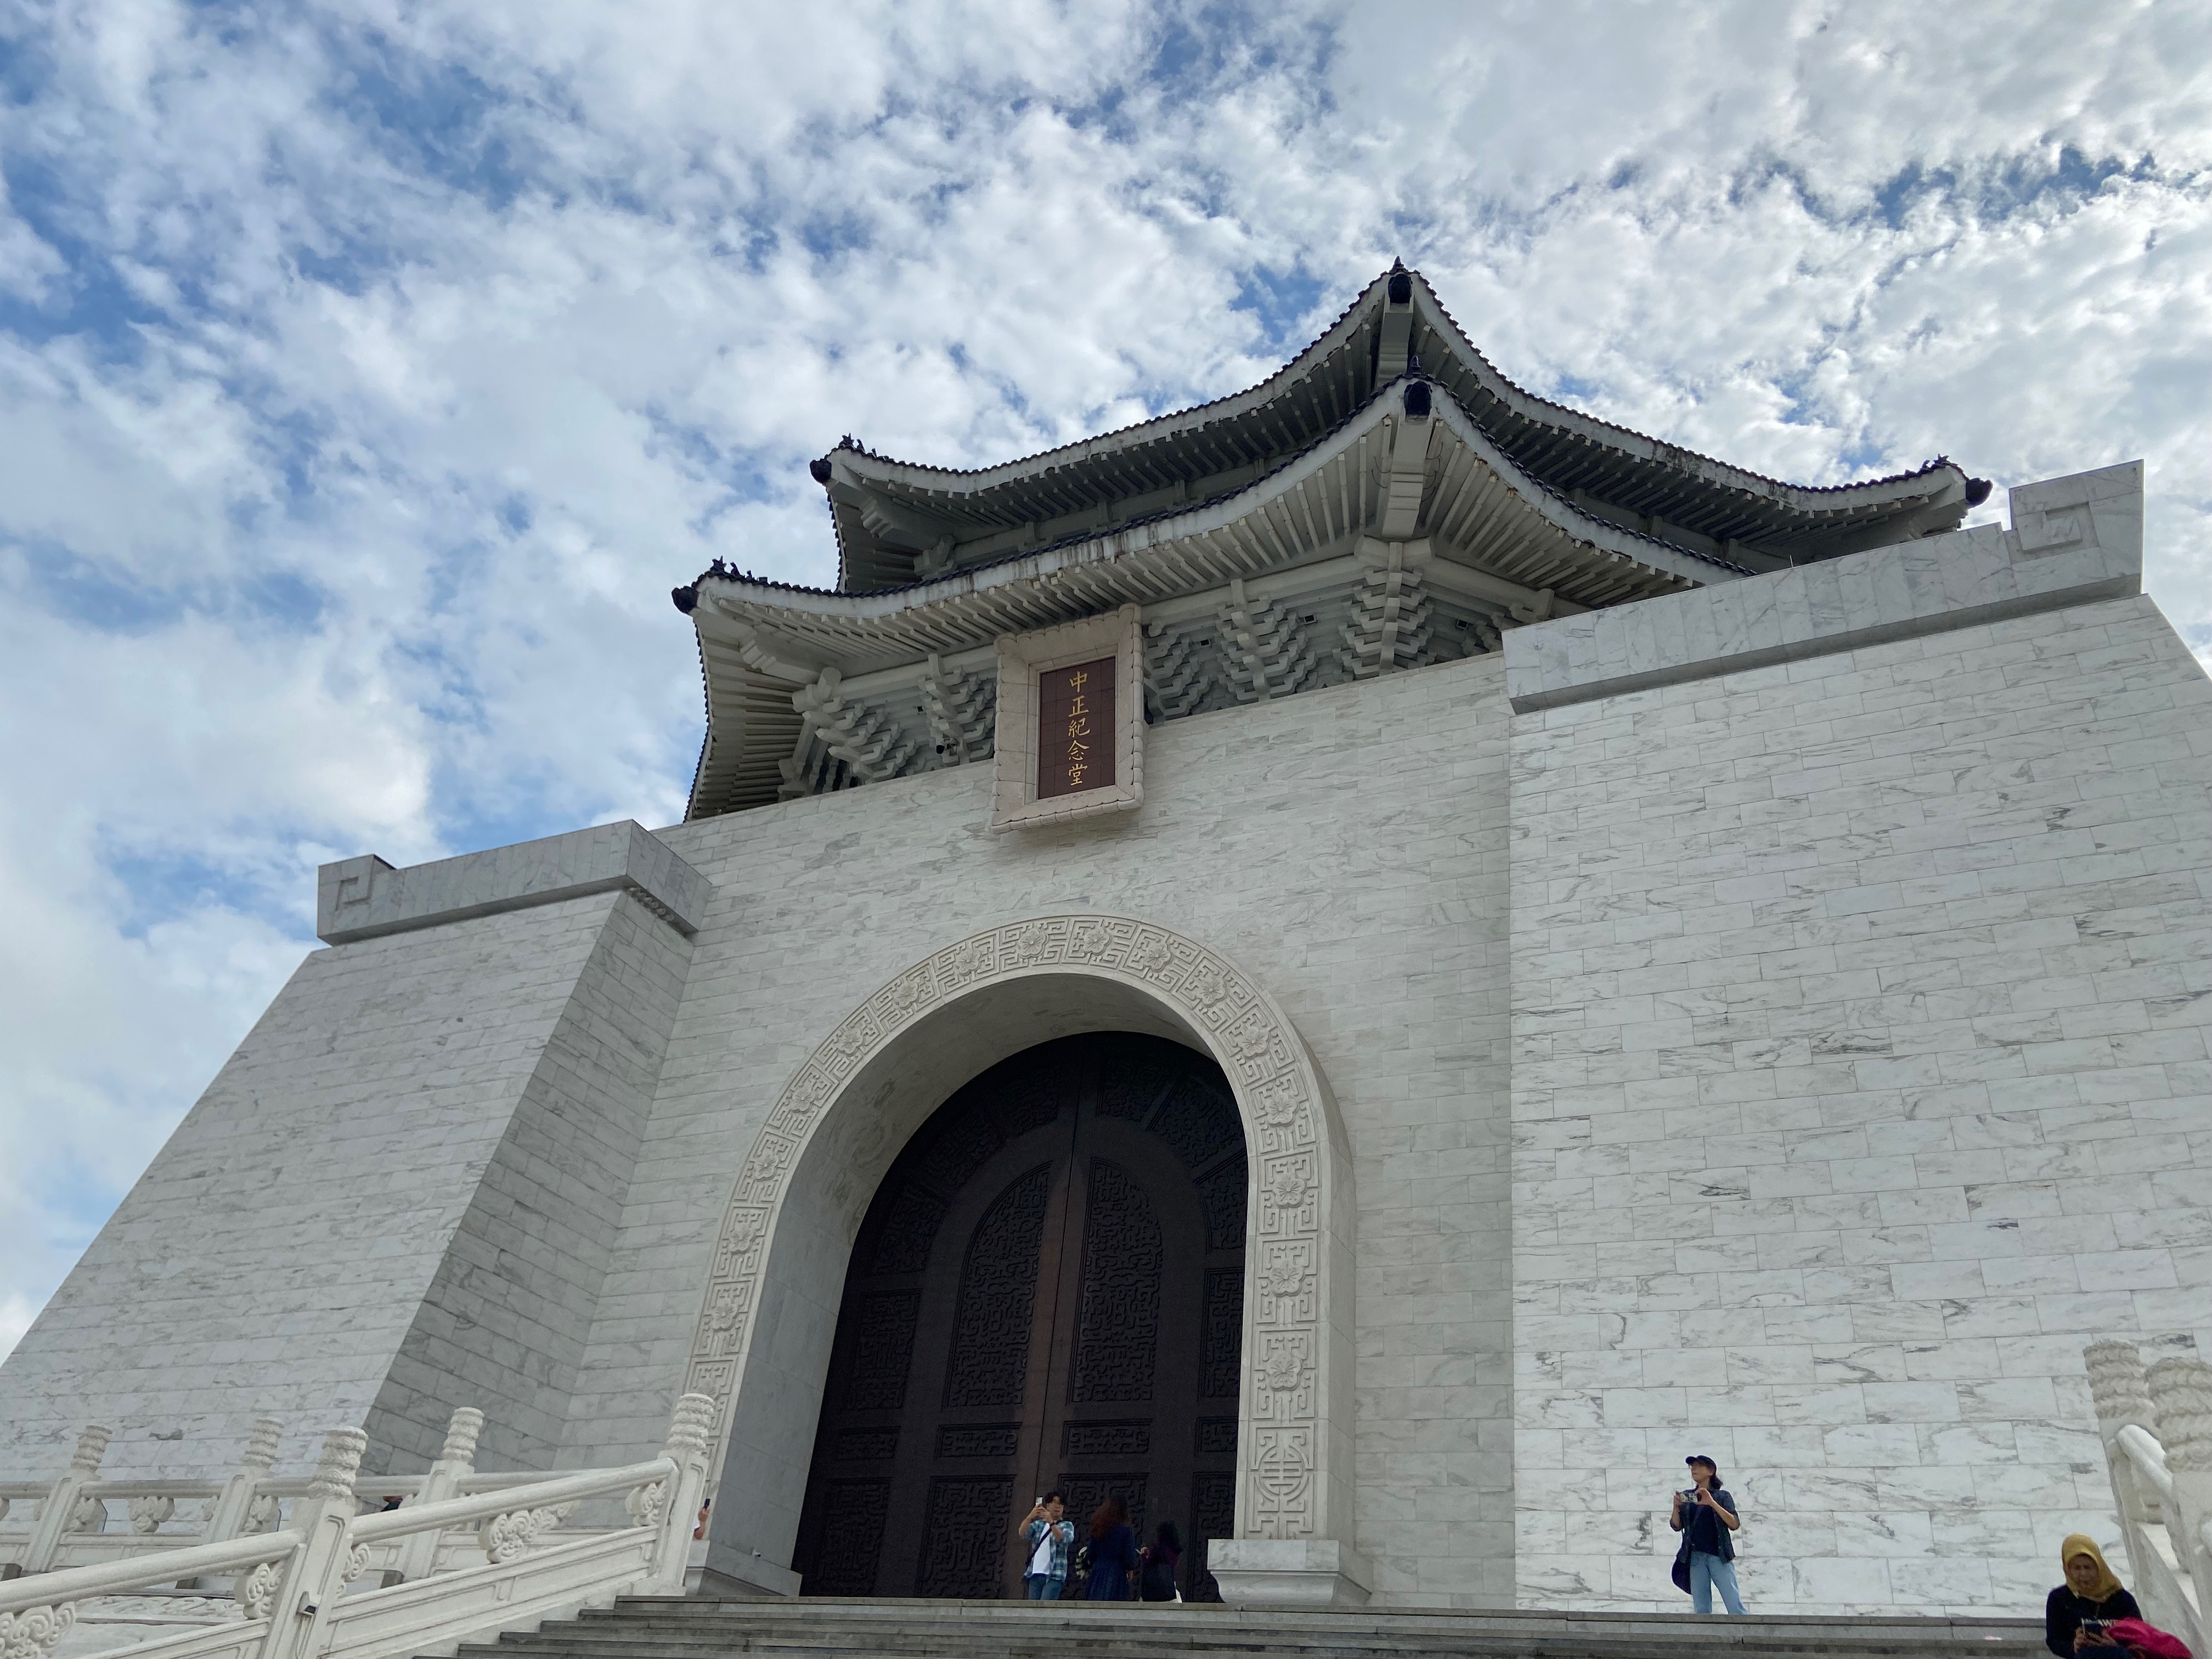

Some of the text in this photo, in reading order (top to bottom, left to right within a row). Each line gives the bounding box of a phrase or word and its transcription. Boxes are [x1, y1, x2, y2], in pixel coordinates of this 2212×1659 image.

[1068, 671, 1091, 786] 中正紀念堂
